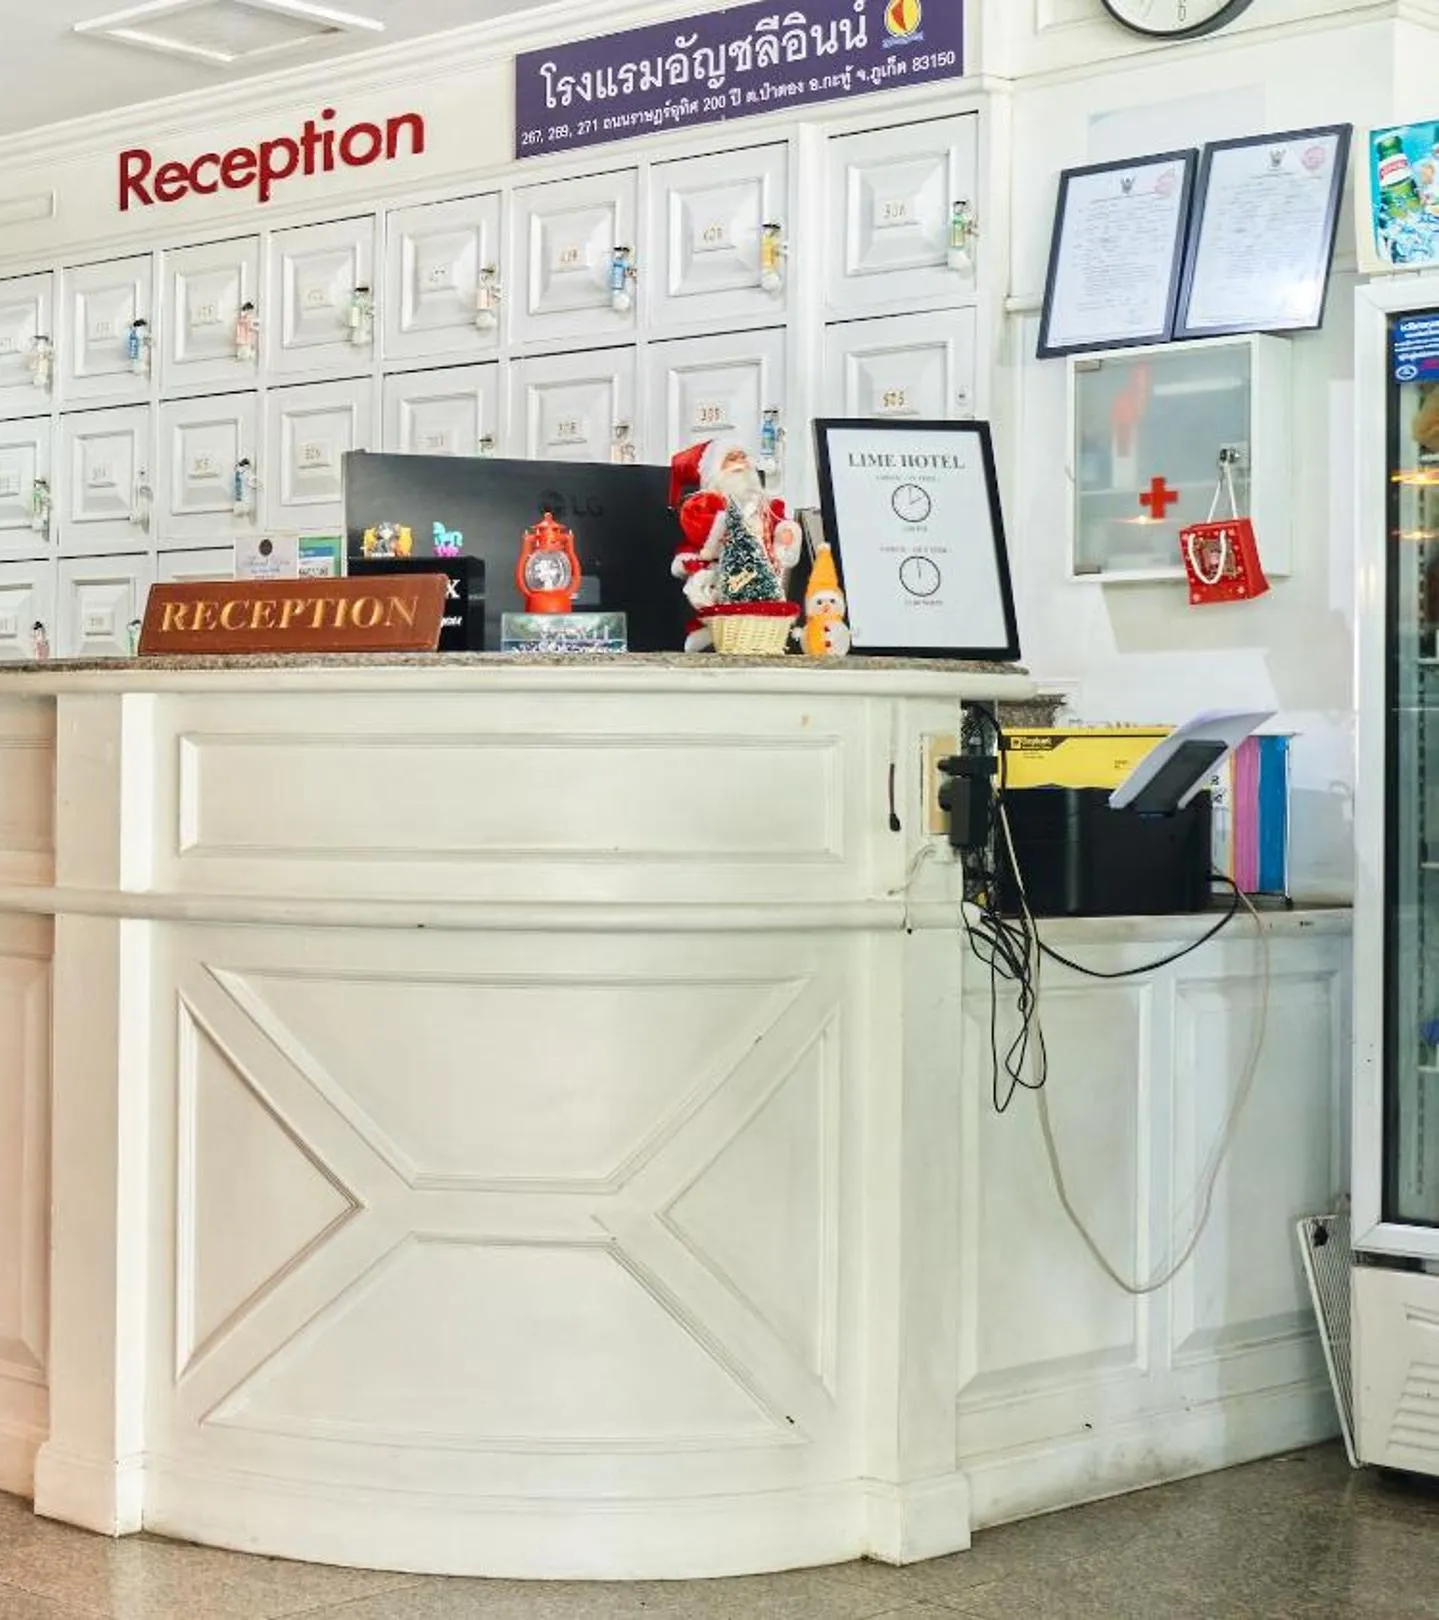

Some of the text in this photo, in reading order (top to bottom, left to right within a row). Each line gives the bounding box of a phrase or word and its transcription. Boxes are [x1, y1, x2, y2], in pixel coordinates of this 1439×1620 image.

[521, 130, 544, 145] 267,
[548, 125, 573, 140] 269,
[577, 120, 598, 135] 271
[703, 95, 726, 112] 200
[729, 88, 741, 107] ปี
[912, 51, 956, 72] 83150
[539, 0, 868, 109] โรงแรมอัญชลีอินน์
[118, 107, 425, 212] Reception
[848, 452, 966, 470] LIME HOTEL
[159, 595, 419, 632] RECEPTION
